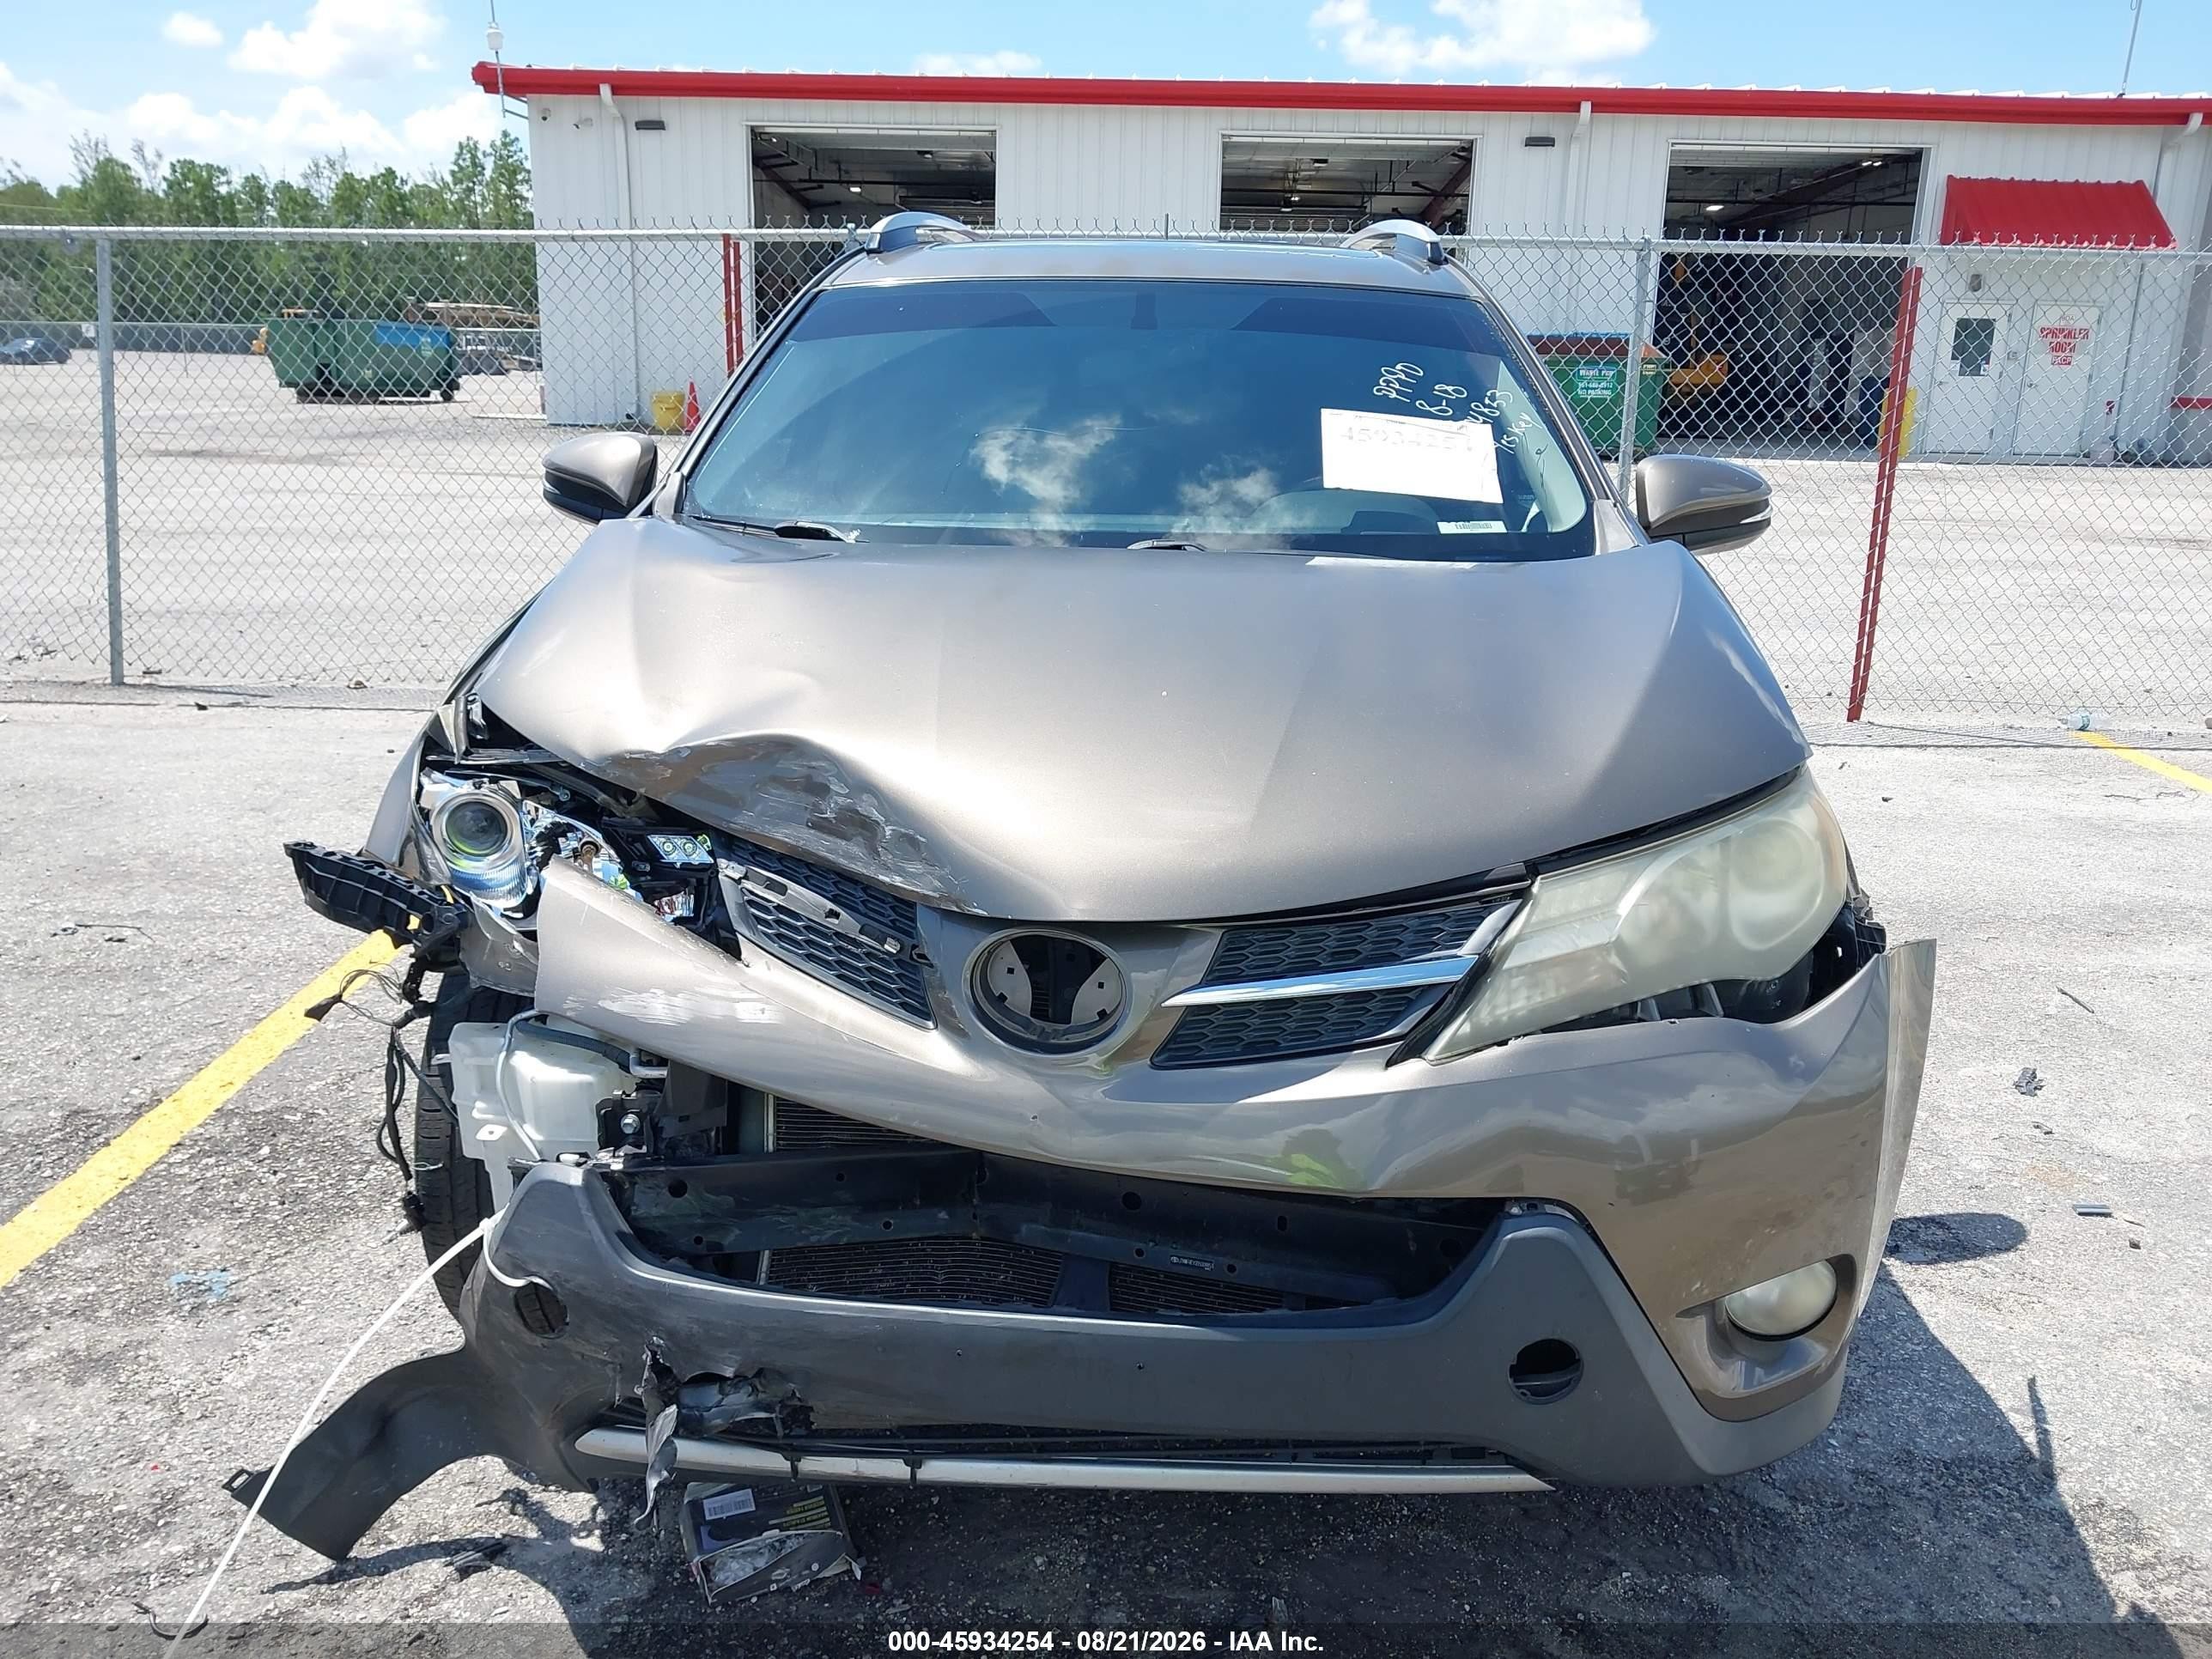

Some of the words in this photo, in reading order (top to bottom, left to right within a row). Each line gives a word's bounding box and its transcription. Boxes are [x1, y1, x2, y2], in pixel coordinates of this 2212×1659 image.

[2039, 327, 2089, 339] SPRINKLER
[2049, 342, 2076, 353] ROOM
[1415, 384, 1468, 416] 8-18
